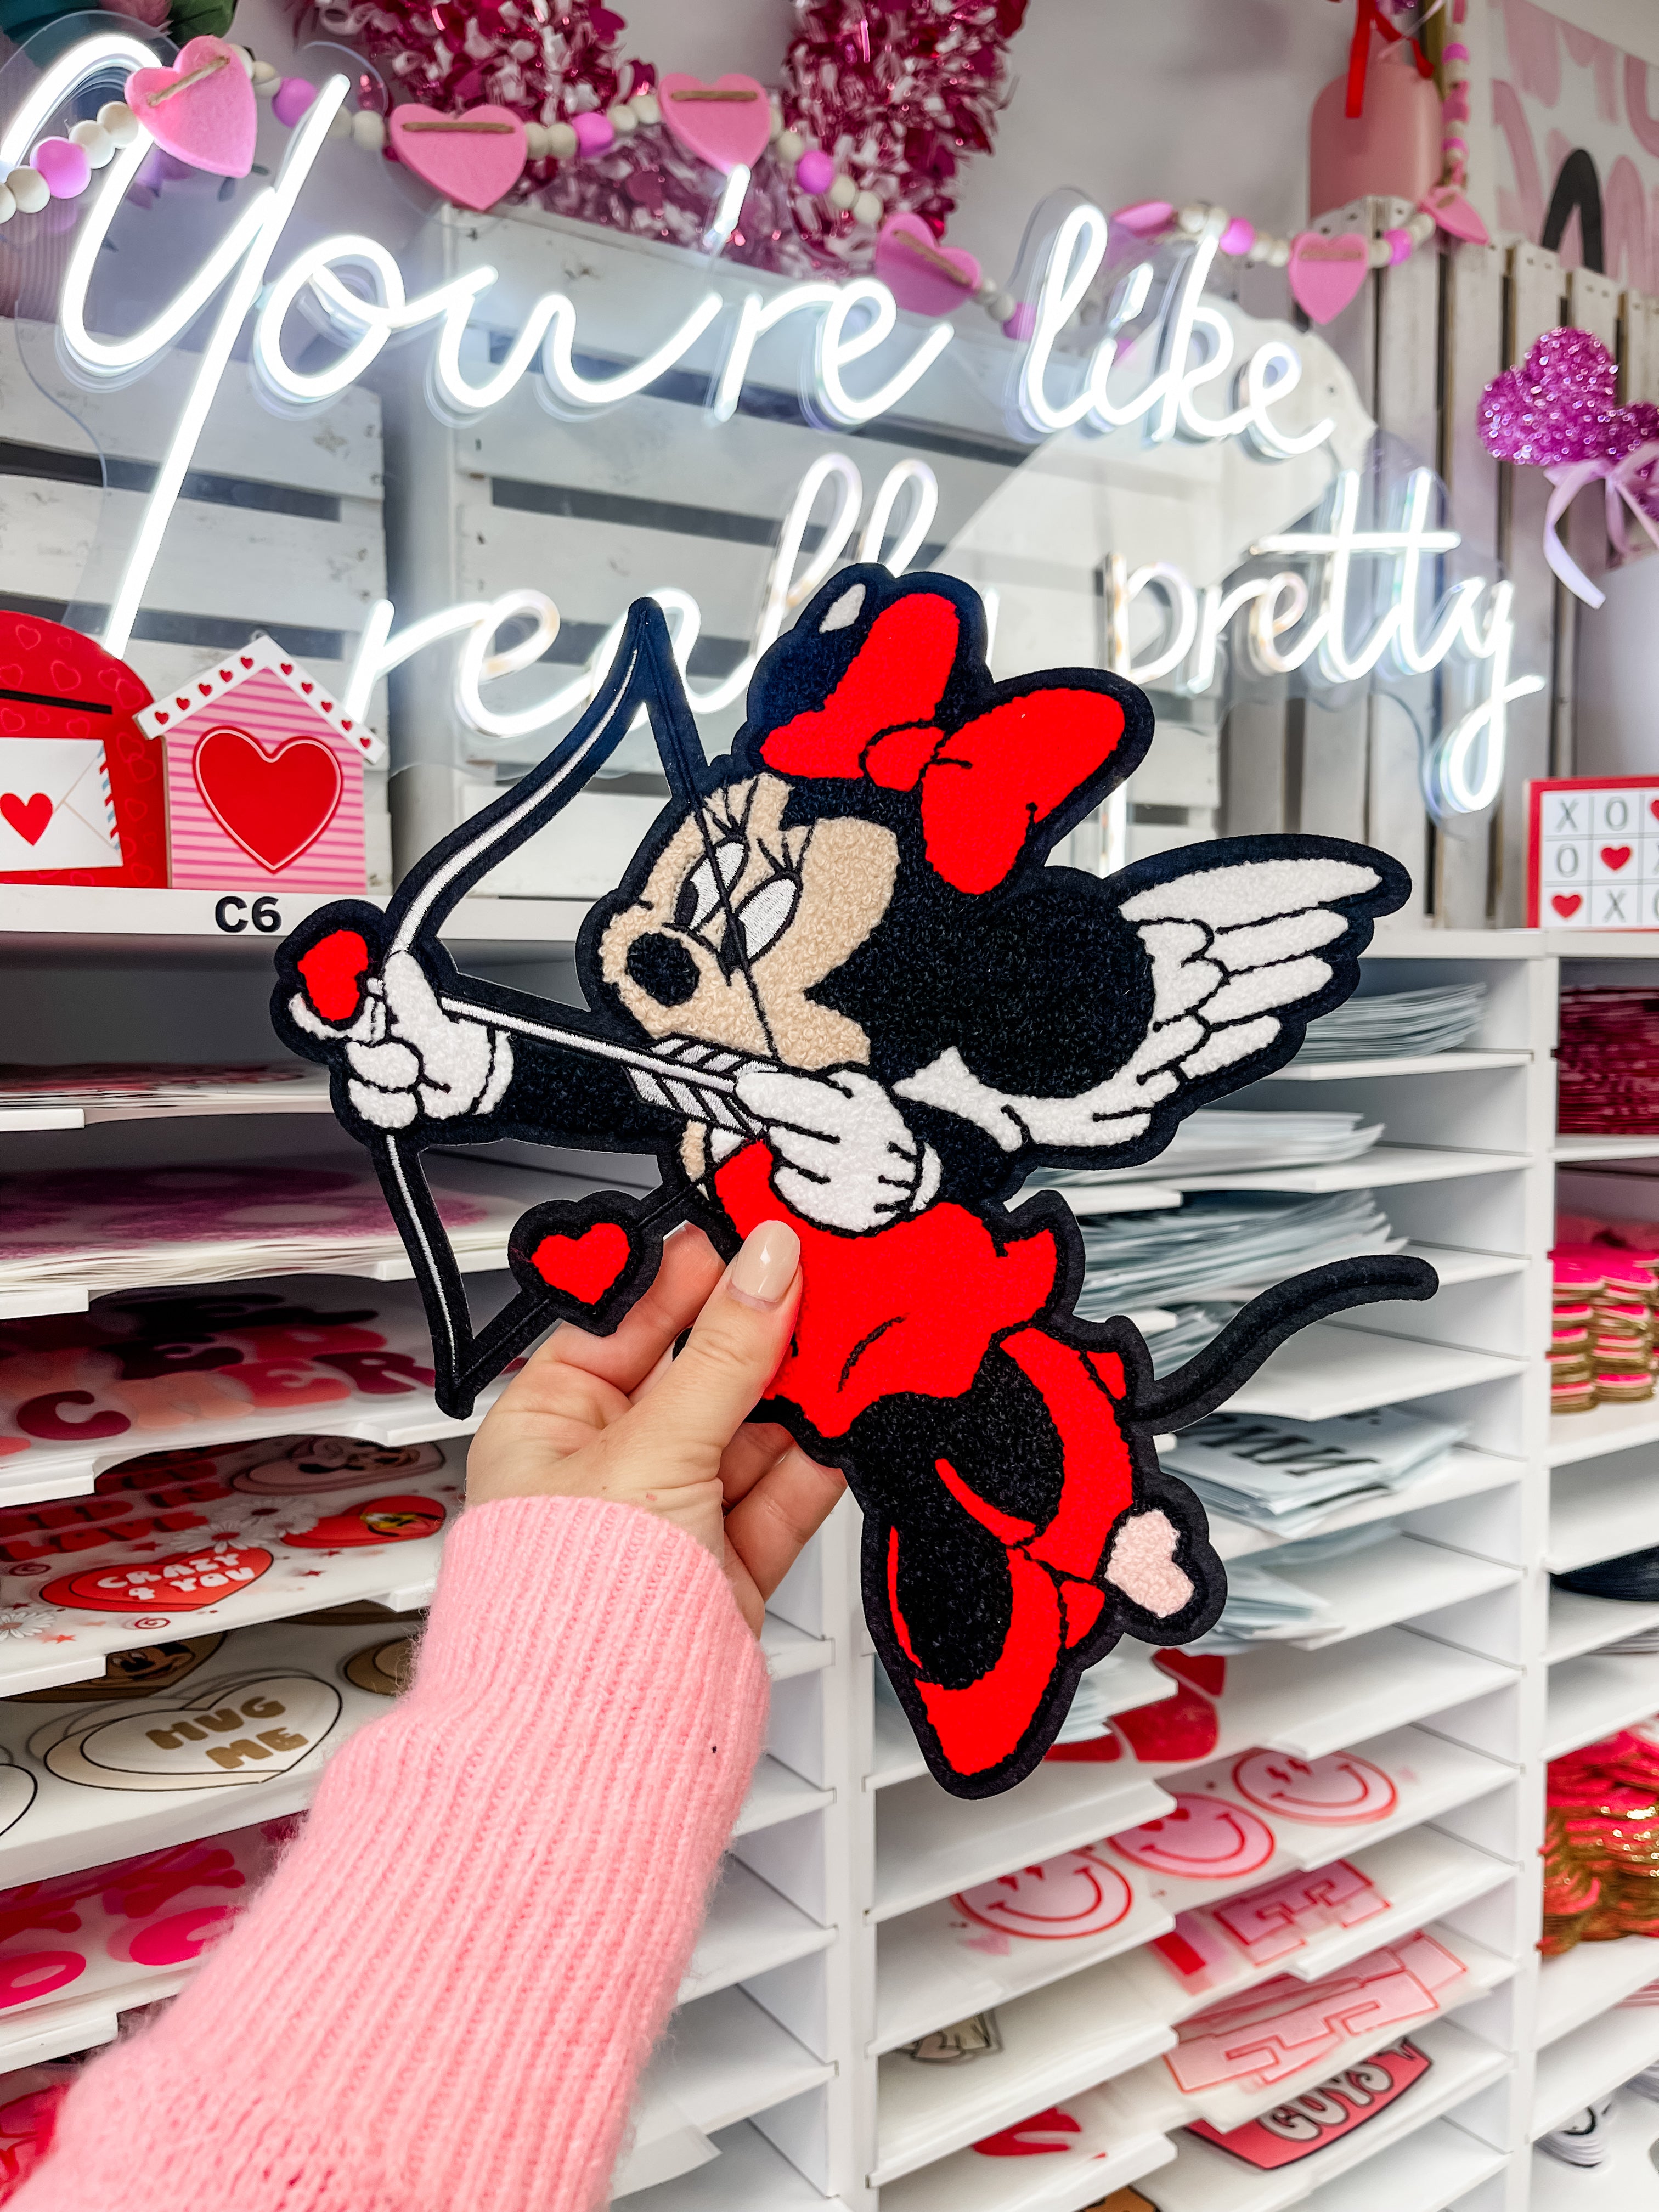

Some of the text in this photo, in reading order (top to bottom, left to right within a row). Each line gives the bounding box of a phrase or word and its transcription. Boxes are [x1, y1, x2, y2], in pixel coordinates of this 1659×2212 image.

[0, 34, 1337, 663] You're like
[342, 453, 1546, 877] reall pretty
[1556, 798, 1579, 833] X
[215, 895, 282, 933] C6
[1604, 888, 1627, 923] X
[97, 1553, 240, 1589] CRAZY
[169, 1566, 255, 1592] YOU
[145, 1696, 286, 1750] HUG
[205, 1726, 309, 1769] ME
